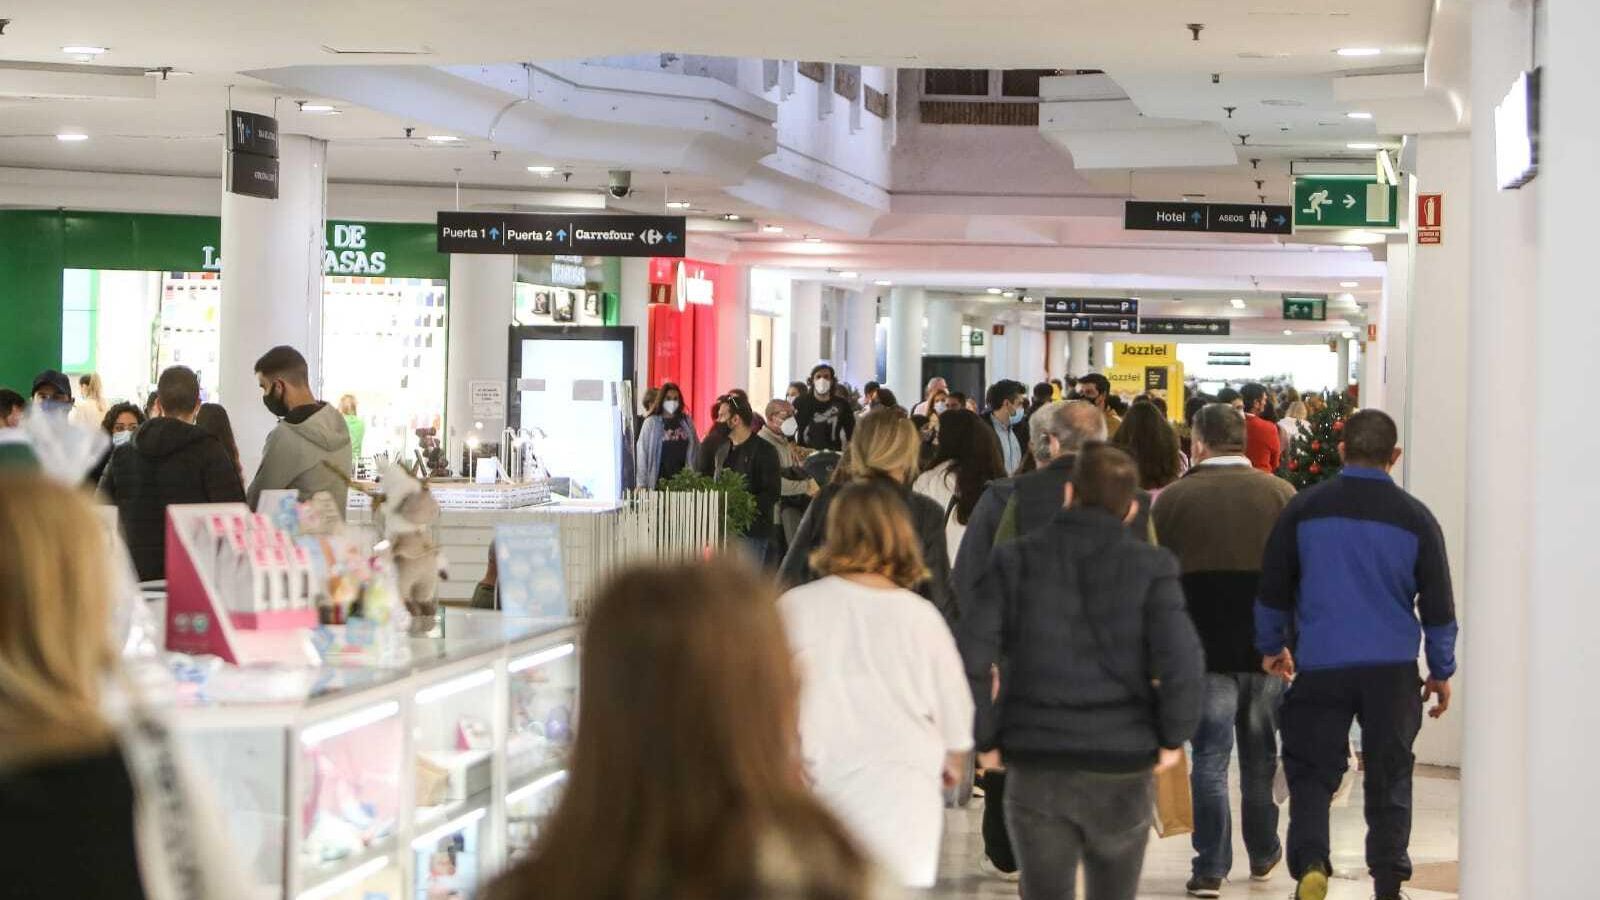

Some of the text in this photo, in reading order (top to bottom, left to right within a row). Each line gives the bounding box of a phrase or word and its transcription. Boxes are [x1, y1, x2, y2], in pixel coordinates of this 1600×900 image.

[1156, 210, 1186, 223] Hotel
[1218, 214, 1244, 223] ASEOS
[334, 224, 367, 248] DE
[442, 227, 486, 239] Puerta 1
[507, 229, 553, 241] Puerta 2
[575, 229, 635, 241] Carrefour
[325, 250, 386, 274] ASAS
[1121, 343, 1167, 356] Jazztel
